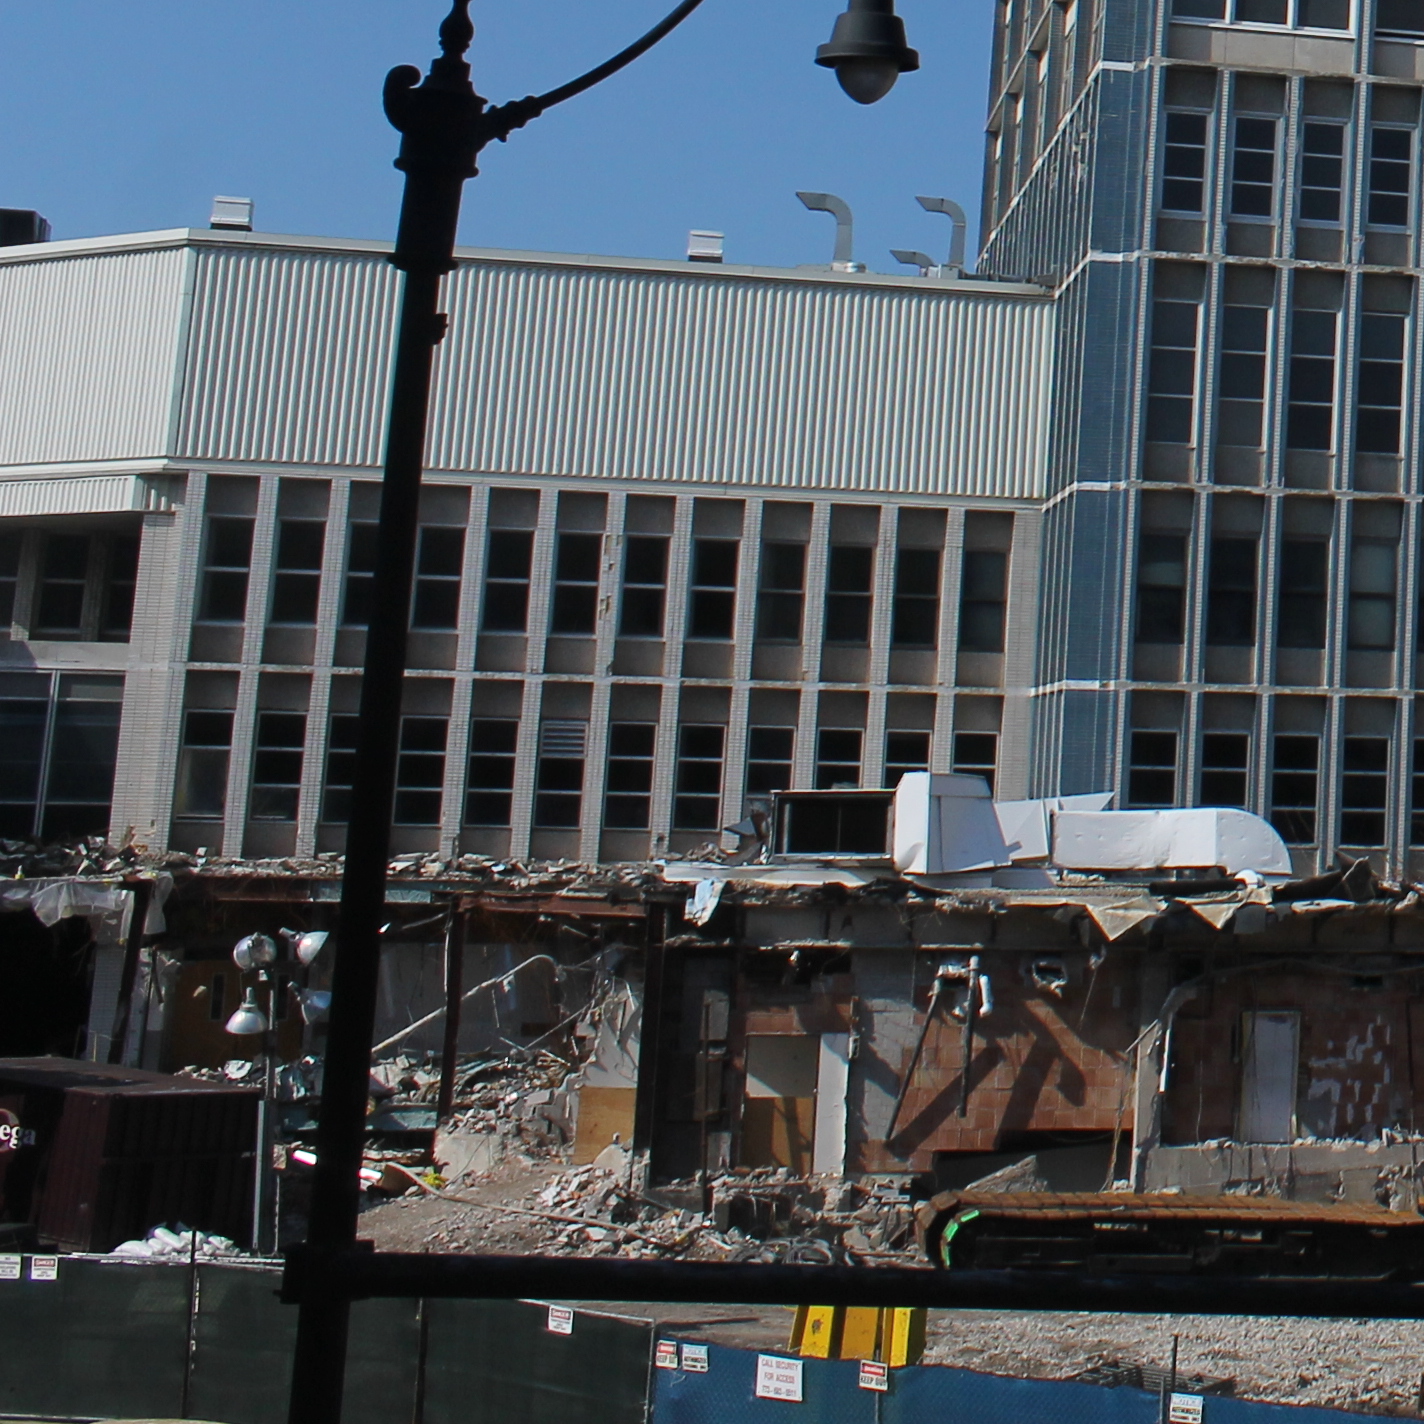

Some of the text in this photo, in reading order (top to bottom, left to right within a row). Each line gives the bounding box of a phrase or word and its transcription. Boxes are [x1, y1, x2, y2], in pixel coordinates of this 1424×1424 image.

[761, 1358, 798, 1371] CALL SECURITY
[764, 1372, 795, 1384] FOR ACCESS
